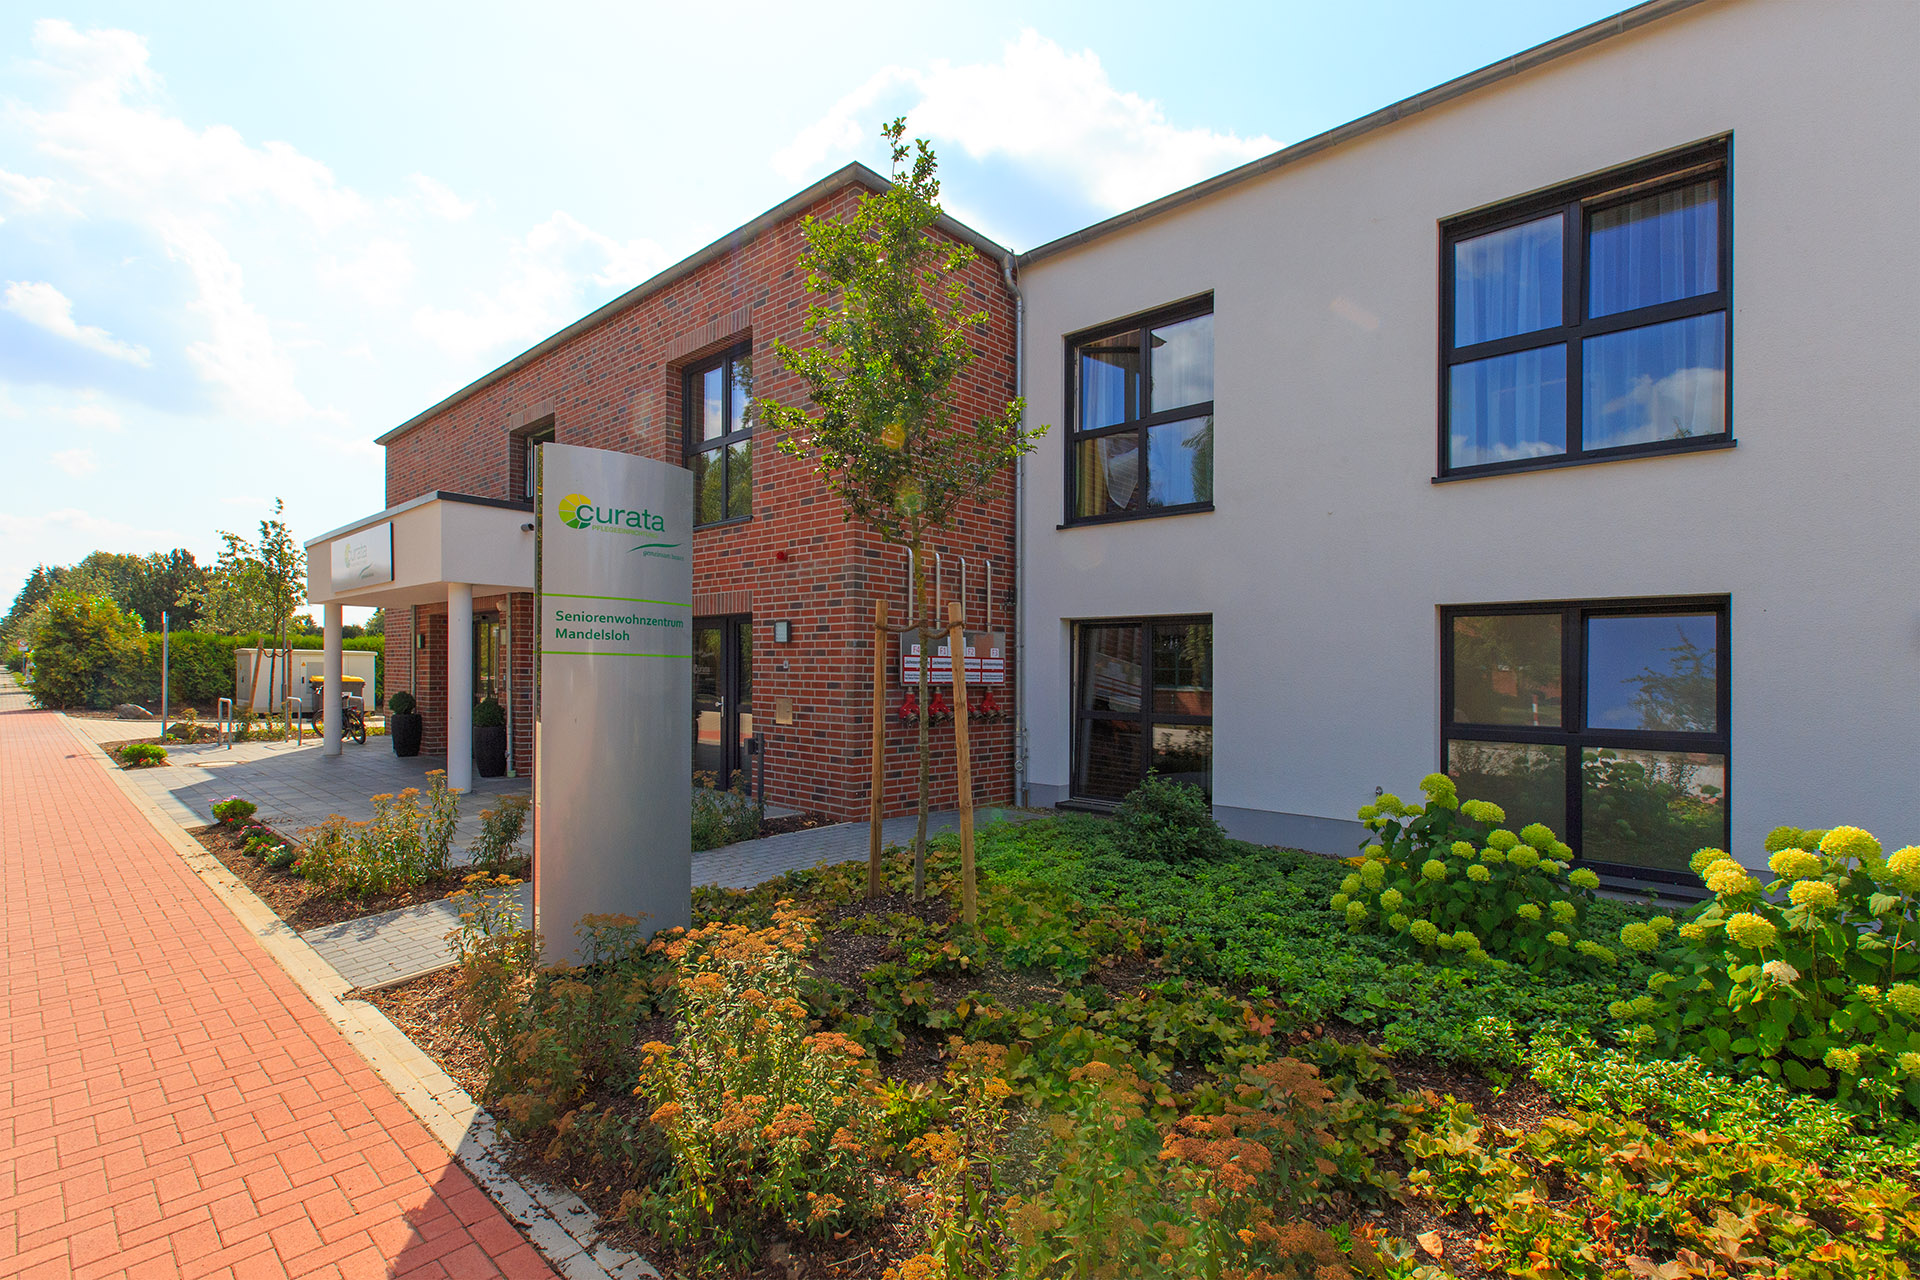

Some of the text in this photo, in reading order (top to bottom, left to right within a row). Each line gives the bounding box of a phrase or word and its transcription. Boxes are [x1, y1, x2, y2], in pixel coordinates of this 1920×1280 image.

[576, 504, 665, 532] curata
[555, 610, 684, 628] Seniorenwohnzentrum
[555, 628, 630, 641] Mandelsloh
[967, 648, 975, 656] F2
